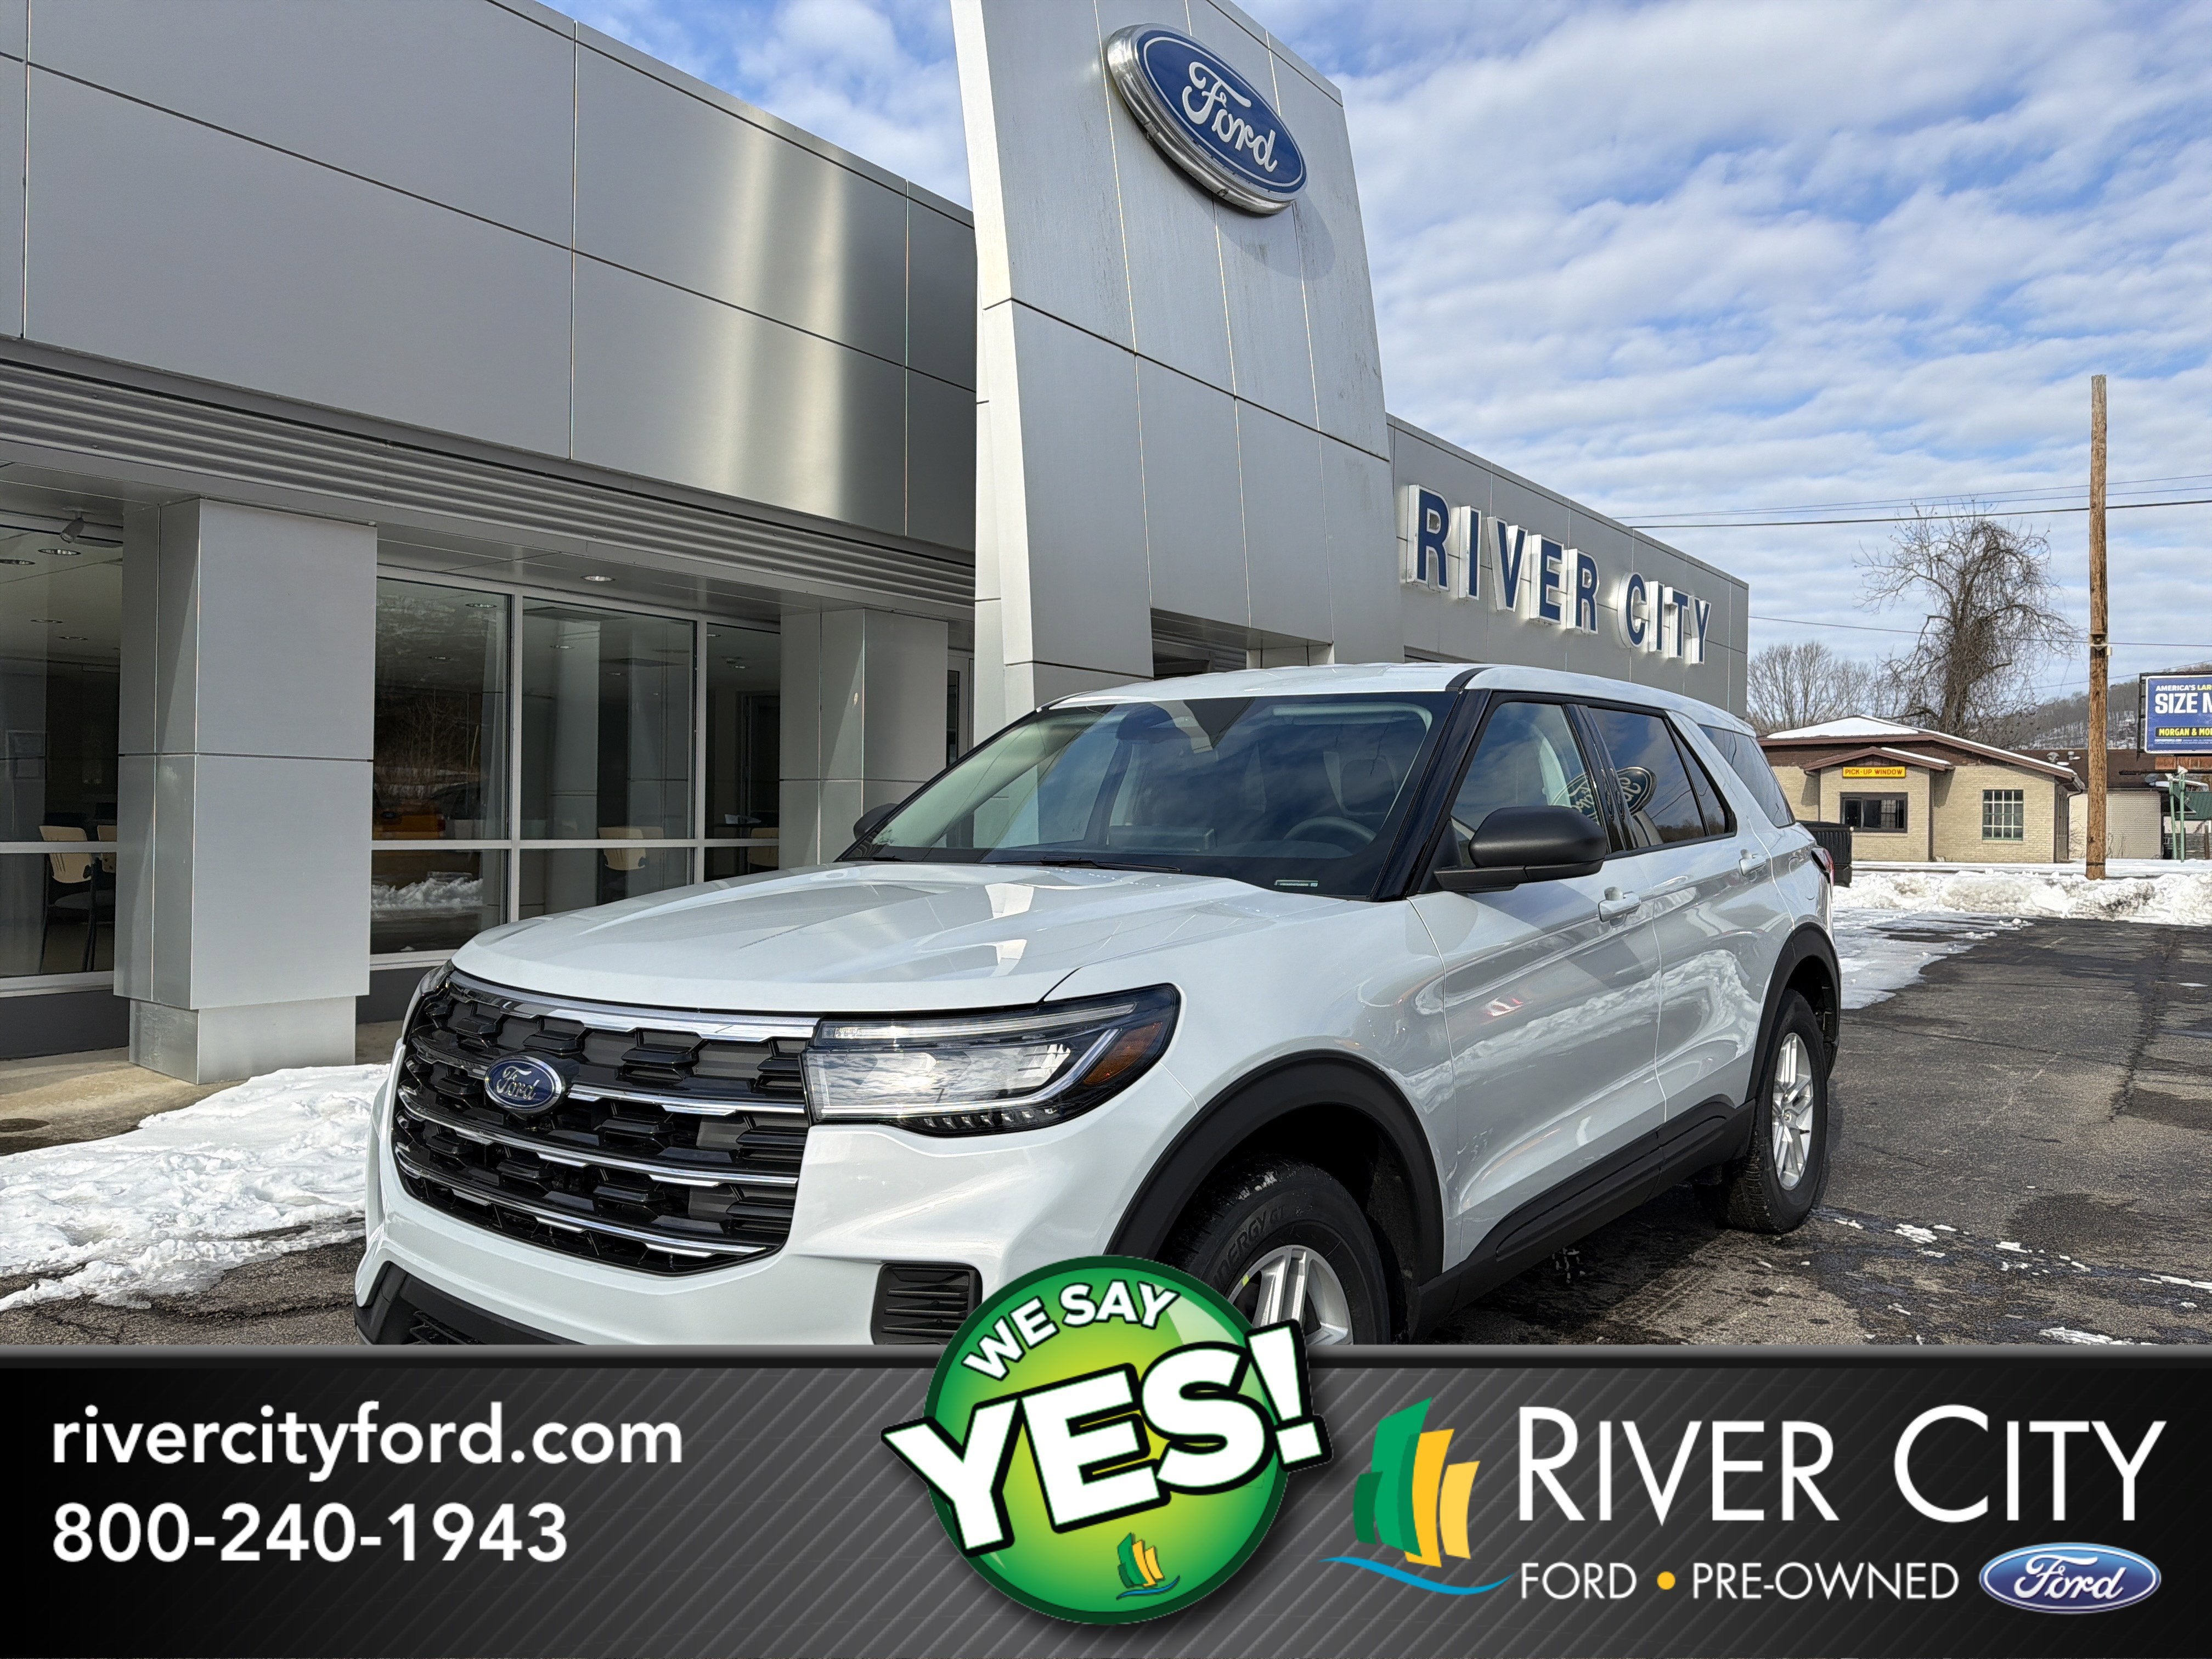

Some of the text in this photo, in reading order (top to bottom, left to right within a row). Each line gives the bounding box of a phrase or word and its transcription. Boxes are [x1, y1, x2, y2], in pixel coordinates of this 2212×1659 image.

[1182, 61, 1277, 172] Ford
[1408, 485, 1712, 665] RIVER CITY
[2155, 692, 2198, 714] SIZE
[2159, 728, 2190, 736] MORGAN
[2192, 728, 2197, 736] &
[496, 1065, 540, 1101] Ford
